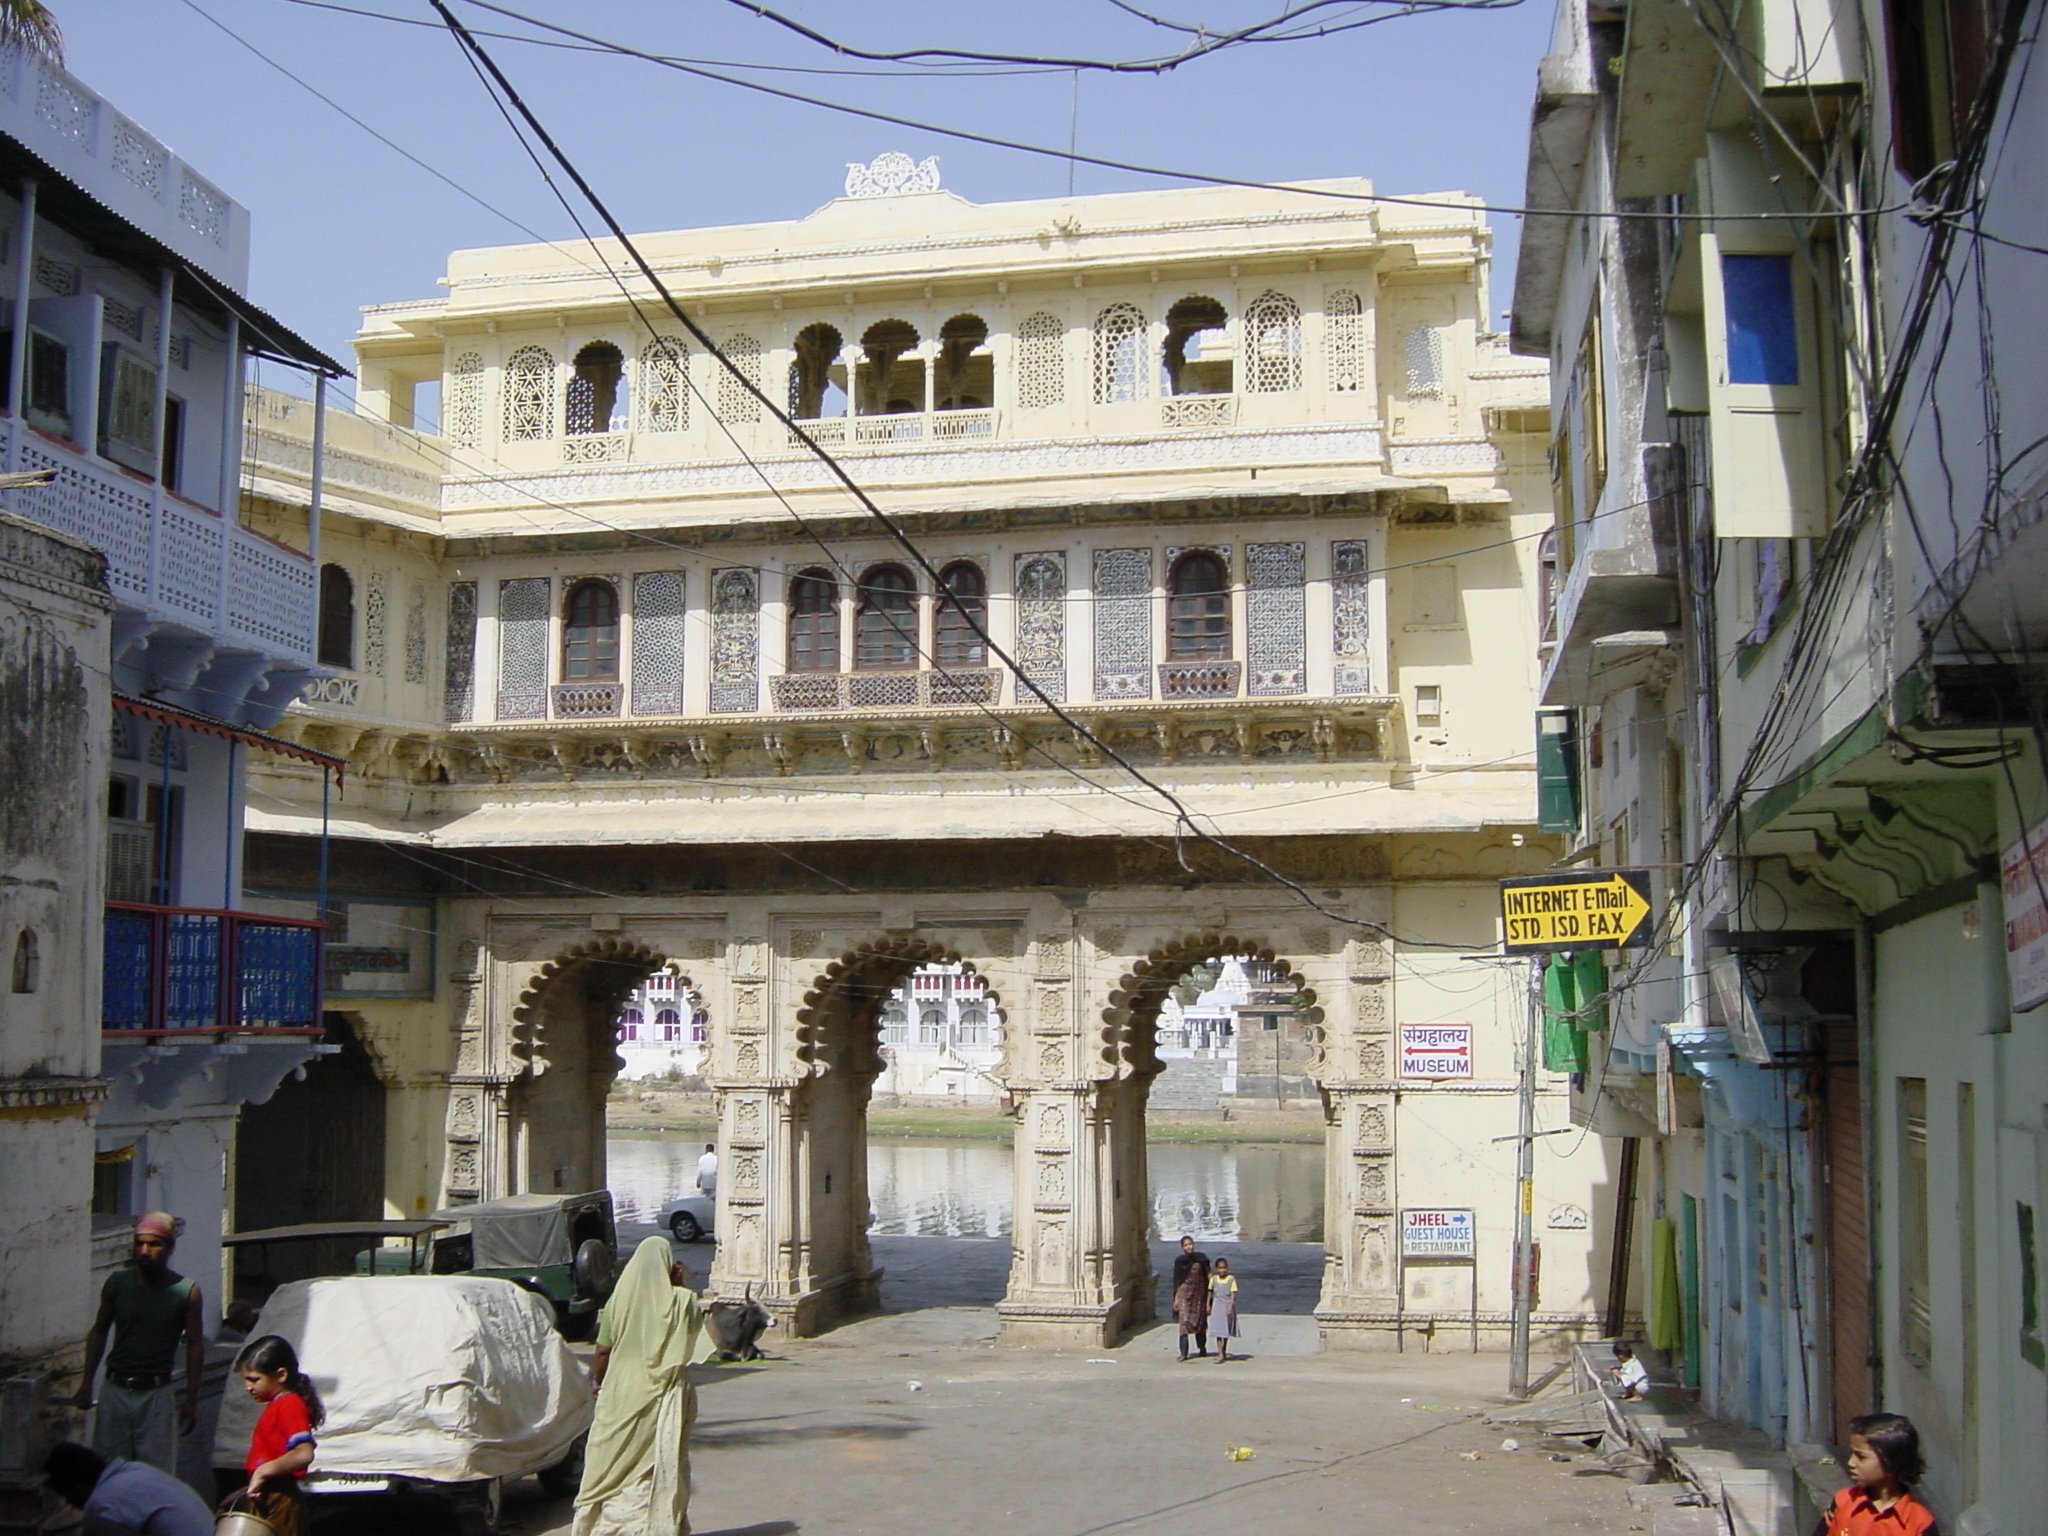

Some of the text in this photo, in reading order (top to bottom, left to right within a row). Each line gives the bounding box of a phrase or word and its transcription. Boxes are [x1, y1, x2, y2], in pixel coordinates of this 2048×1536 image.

[1507, 889, 1579, 915] INTERNET
[1510, 916, 1544, 940] STD.
[1551, 914, 1583, 938] ISD.
[1403, 1026, 1468, 1047] संग्रहालय
[1403, 1059, 1469, 1073] MUSEUM
[1409, 1213, 1449, 1226] JHEEL
[1404, 1227, 1470, 1240] GUEST HOUSE
[1411, 1241, 1471, 1252] RESTAURANT
